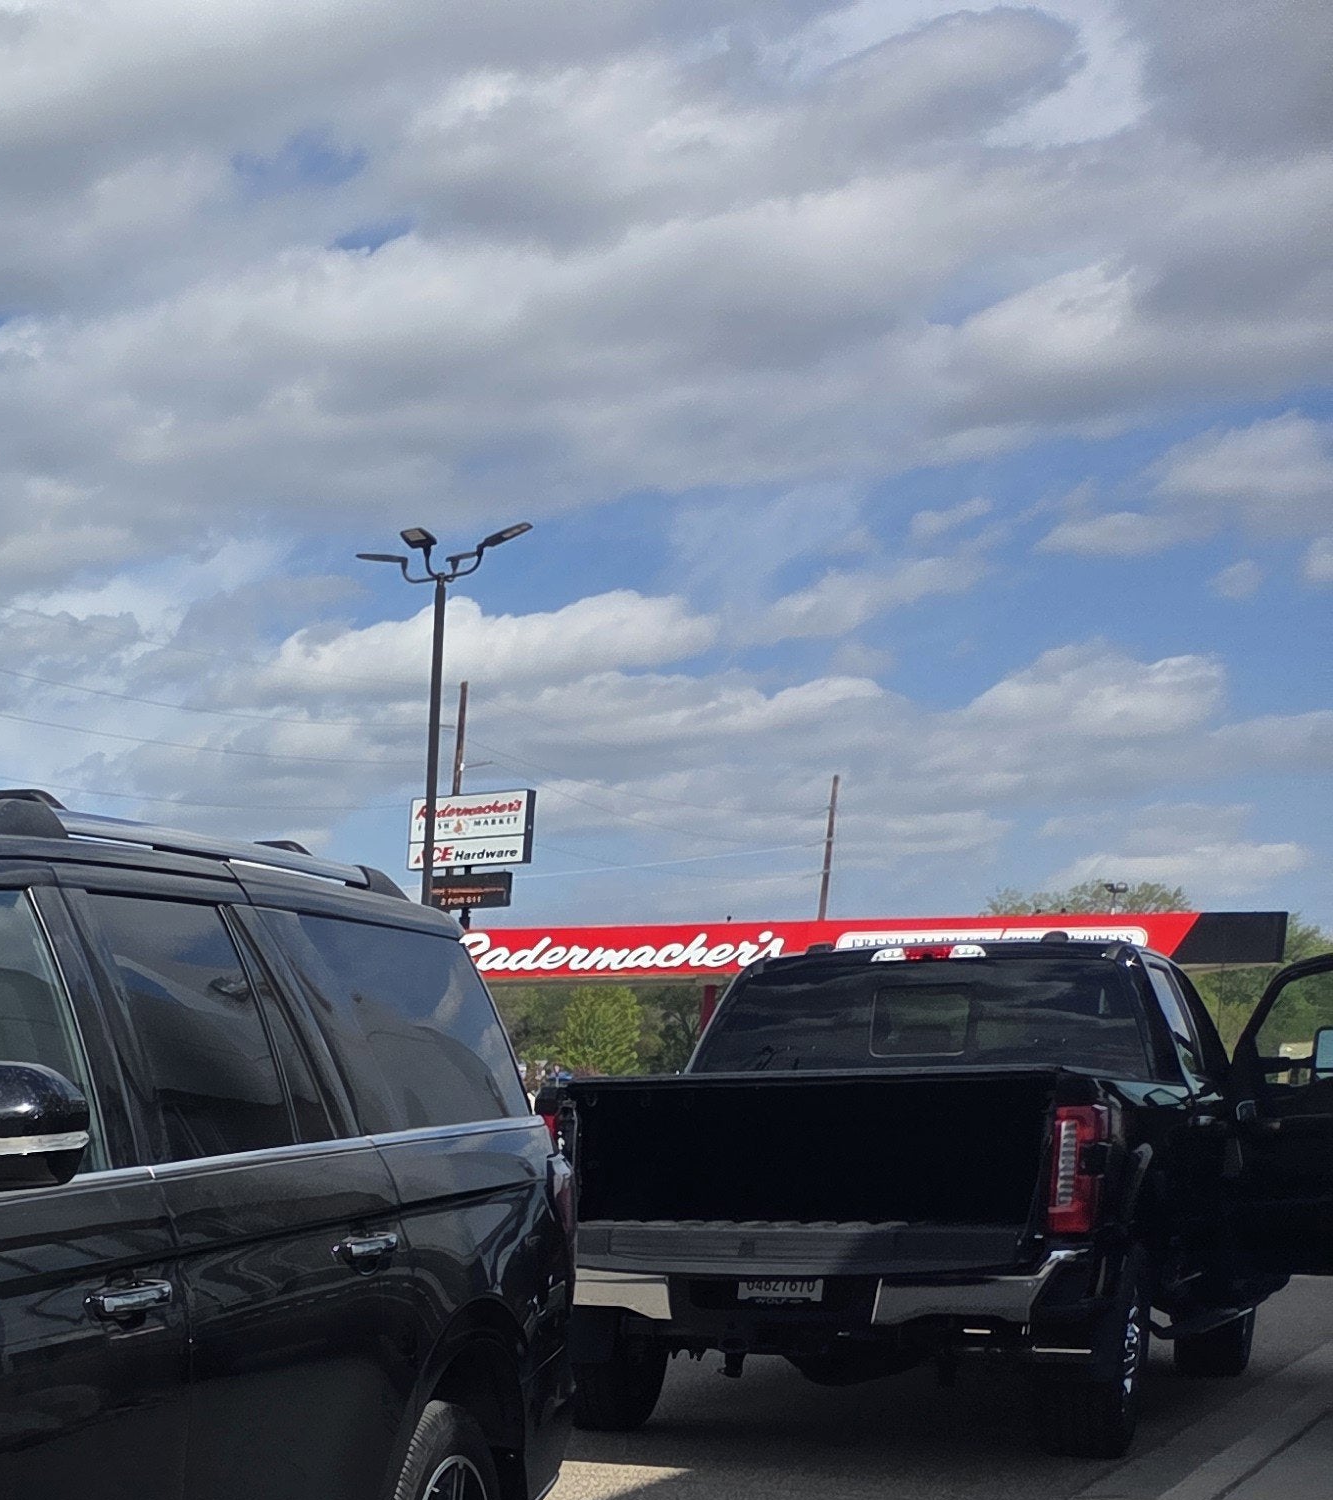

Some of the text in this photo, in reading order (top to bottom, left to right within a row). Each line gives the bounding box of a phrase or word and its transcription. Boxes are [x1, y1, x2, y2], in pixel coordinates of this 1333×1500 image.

[415, 799, 523, 820] Rdermacher's
[473, 816, 518, 826] MARKET
[454, 848, 518, 861] Hardware
[459, 930, 785, 971] Radermacher's
